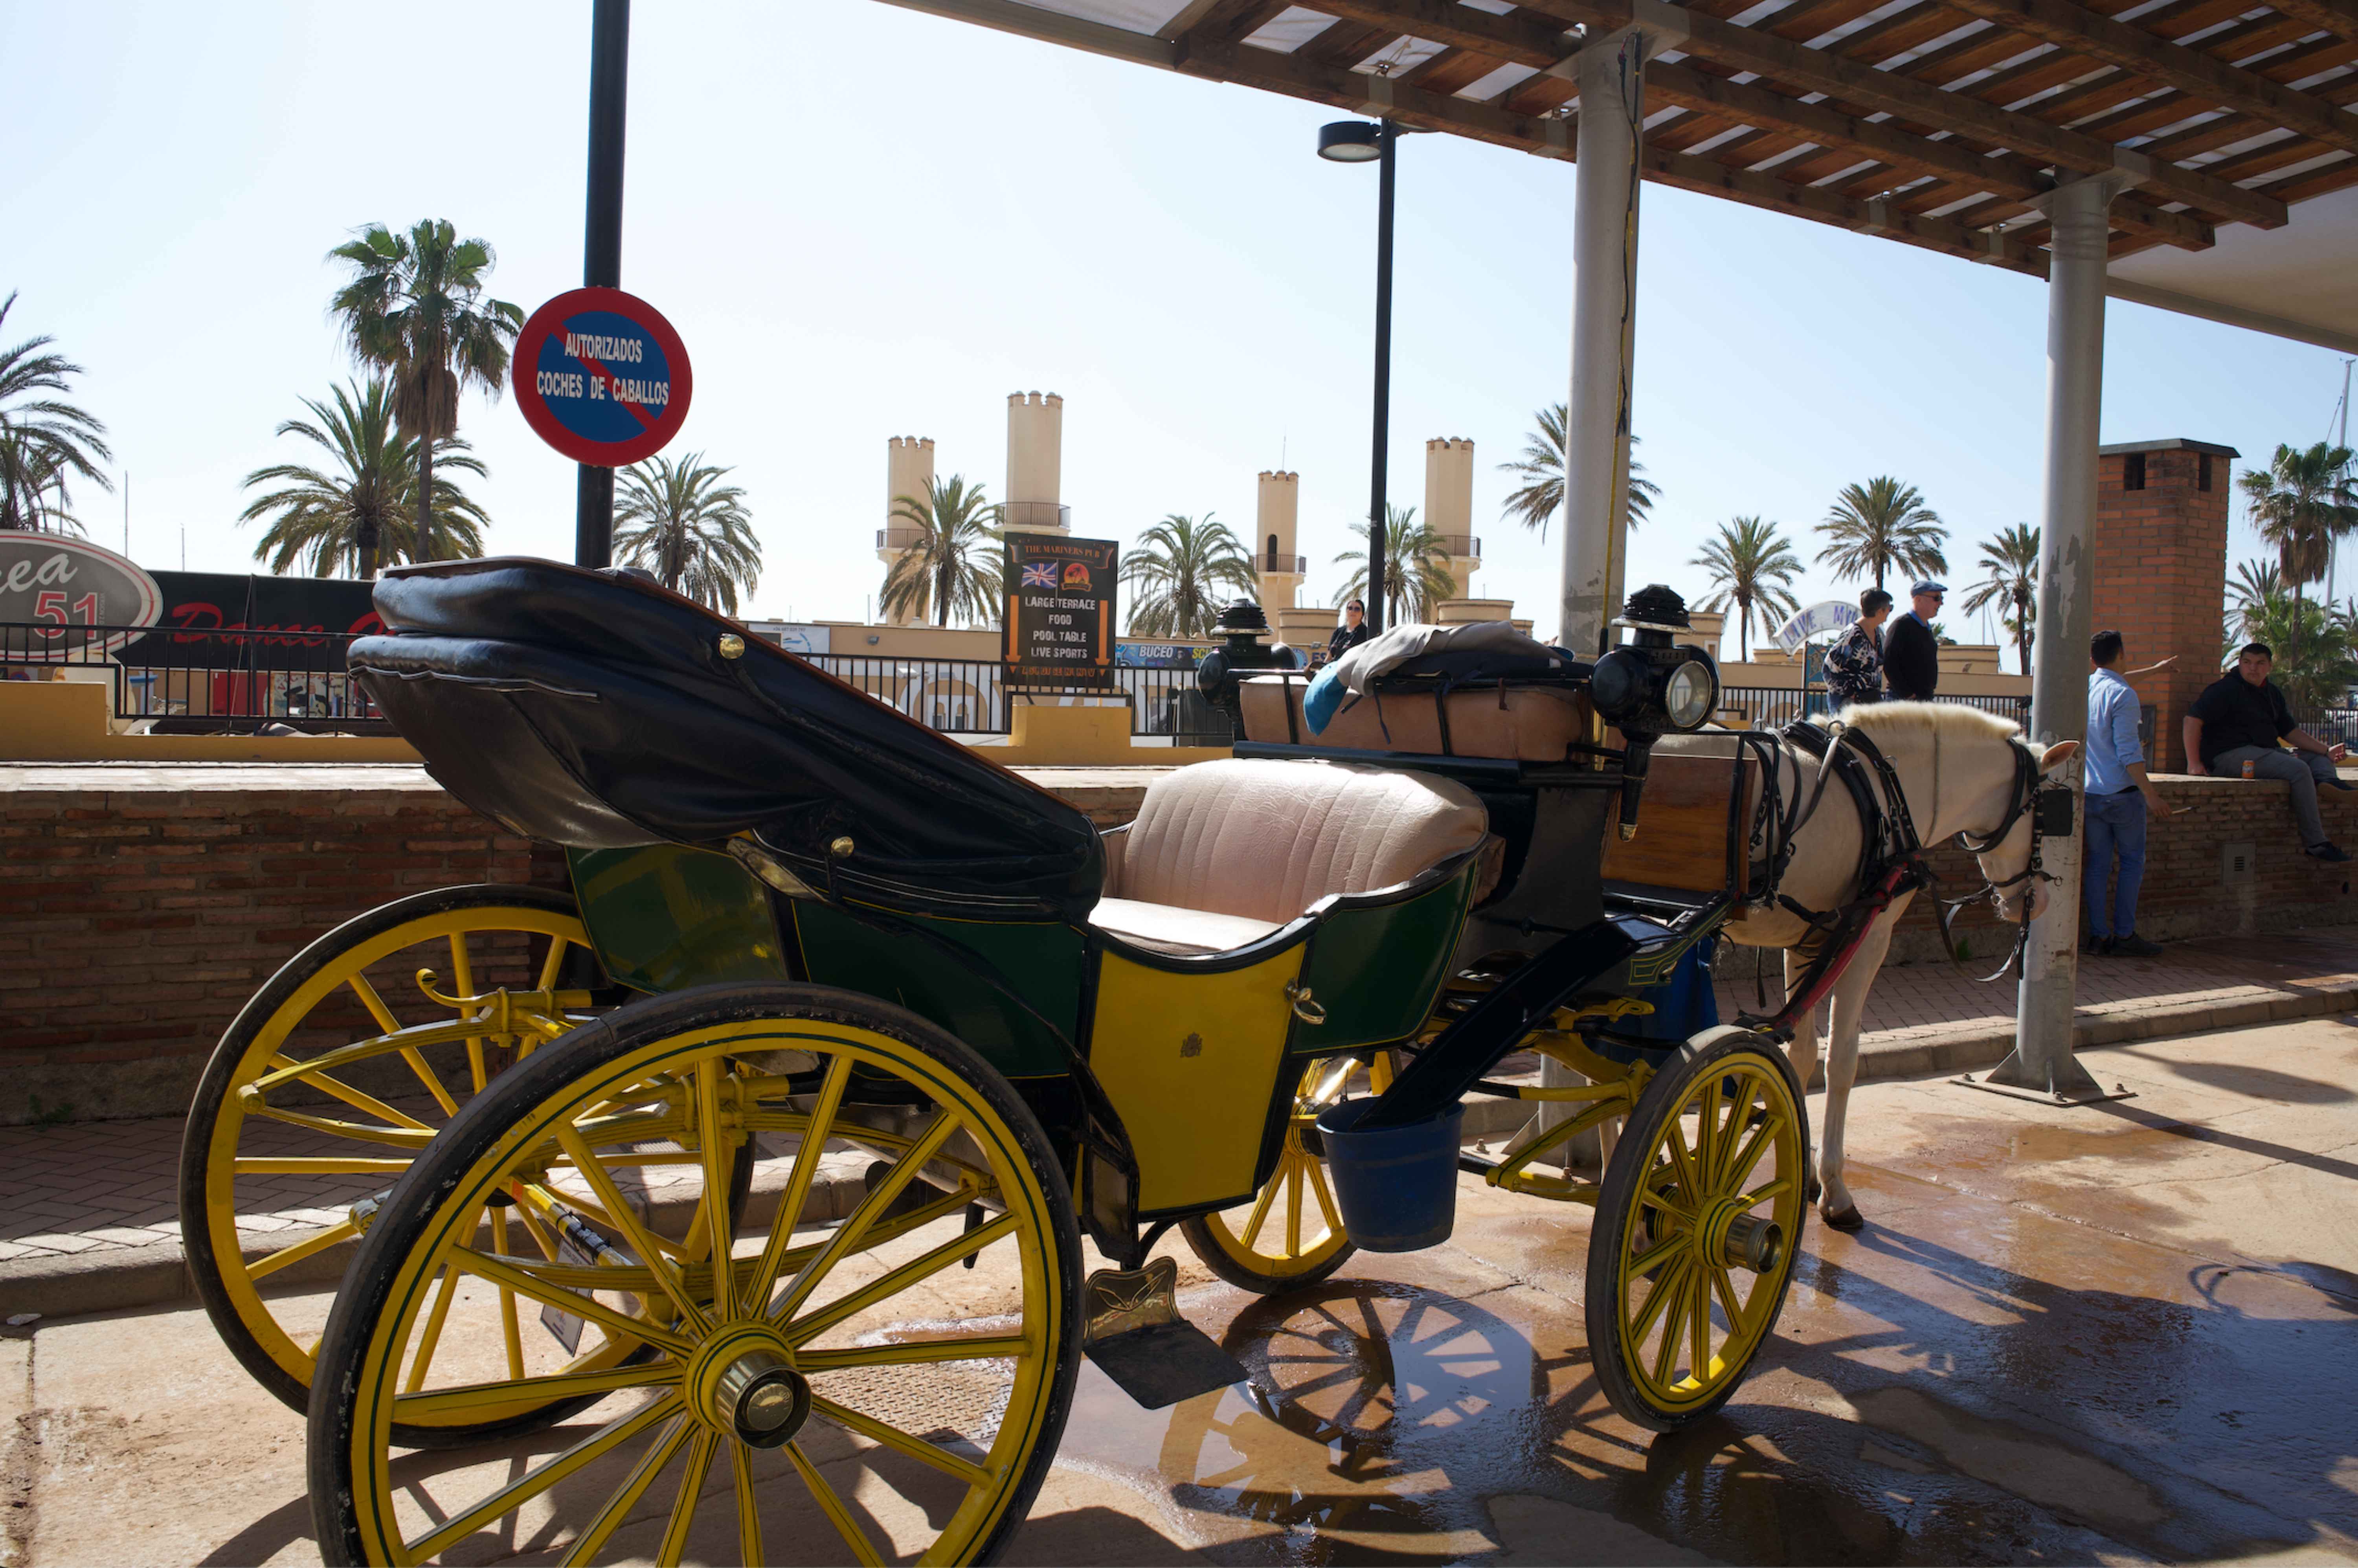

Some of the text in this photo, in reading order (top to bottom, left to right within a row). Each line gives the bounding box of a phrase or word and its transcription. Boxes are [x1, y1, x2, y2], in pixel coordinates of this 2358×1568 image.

[564, 332, 642, 363] AUTORIZADOS
[536, 371, 669, 406] COCHES DE CABALLOS
[1025, 545, 1100, 558] THE MARINERS PUB
[1025, 597, 1095, 610] LARGE TERRACE
[34, 590, 97, 640] 51
[1048, 614, 1072, 625] FOOD
[171, 602, 324, 647] Dance
[1784, 610, 1816, 646] LIVE
[1033, 630, 1086, 642] POOL TABLE
[1031, 647, 1087, 659] LIVE SPORTS
[1139, 646, 1173, 658] BUCEO
